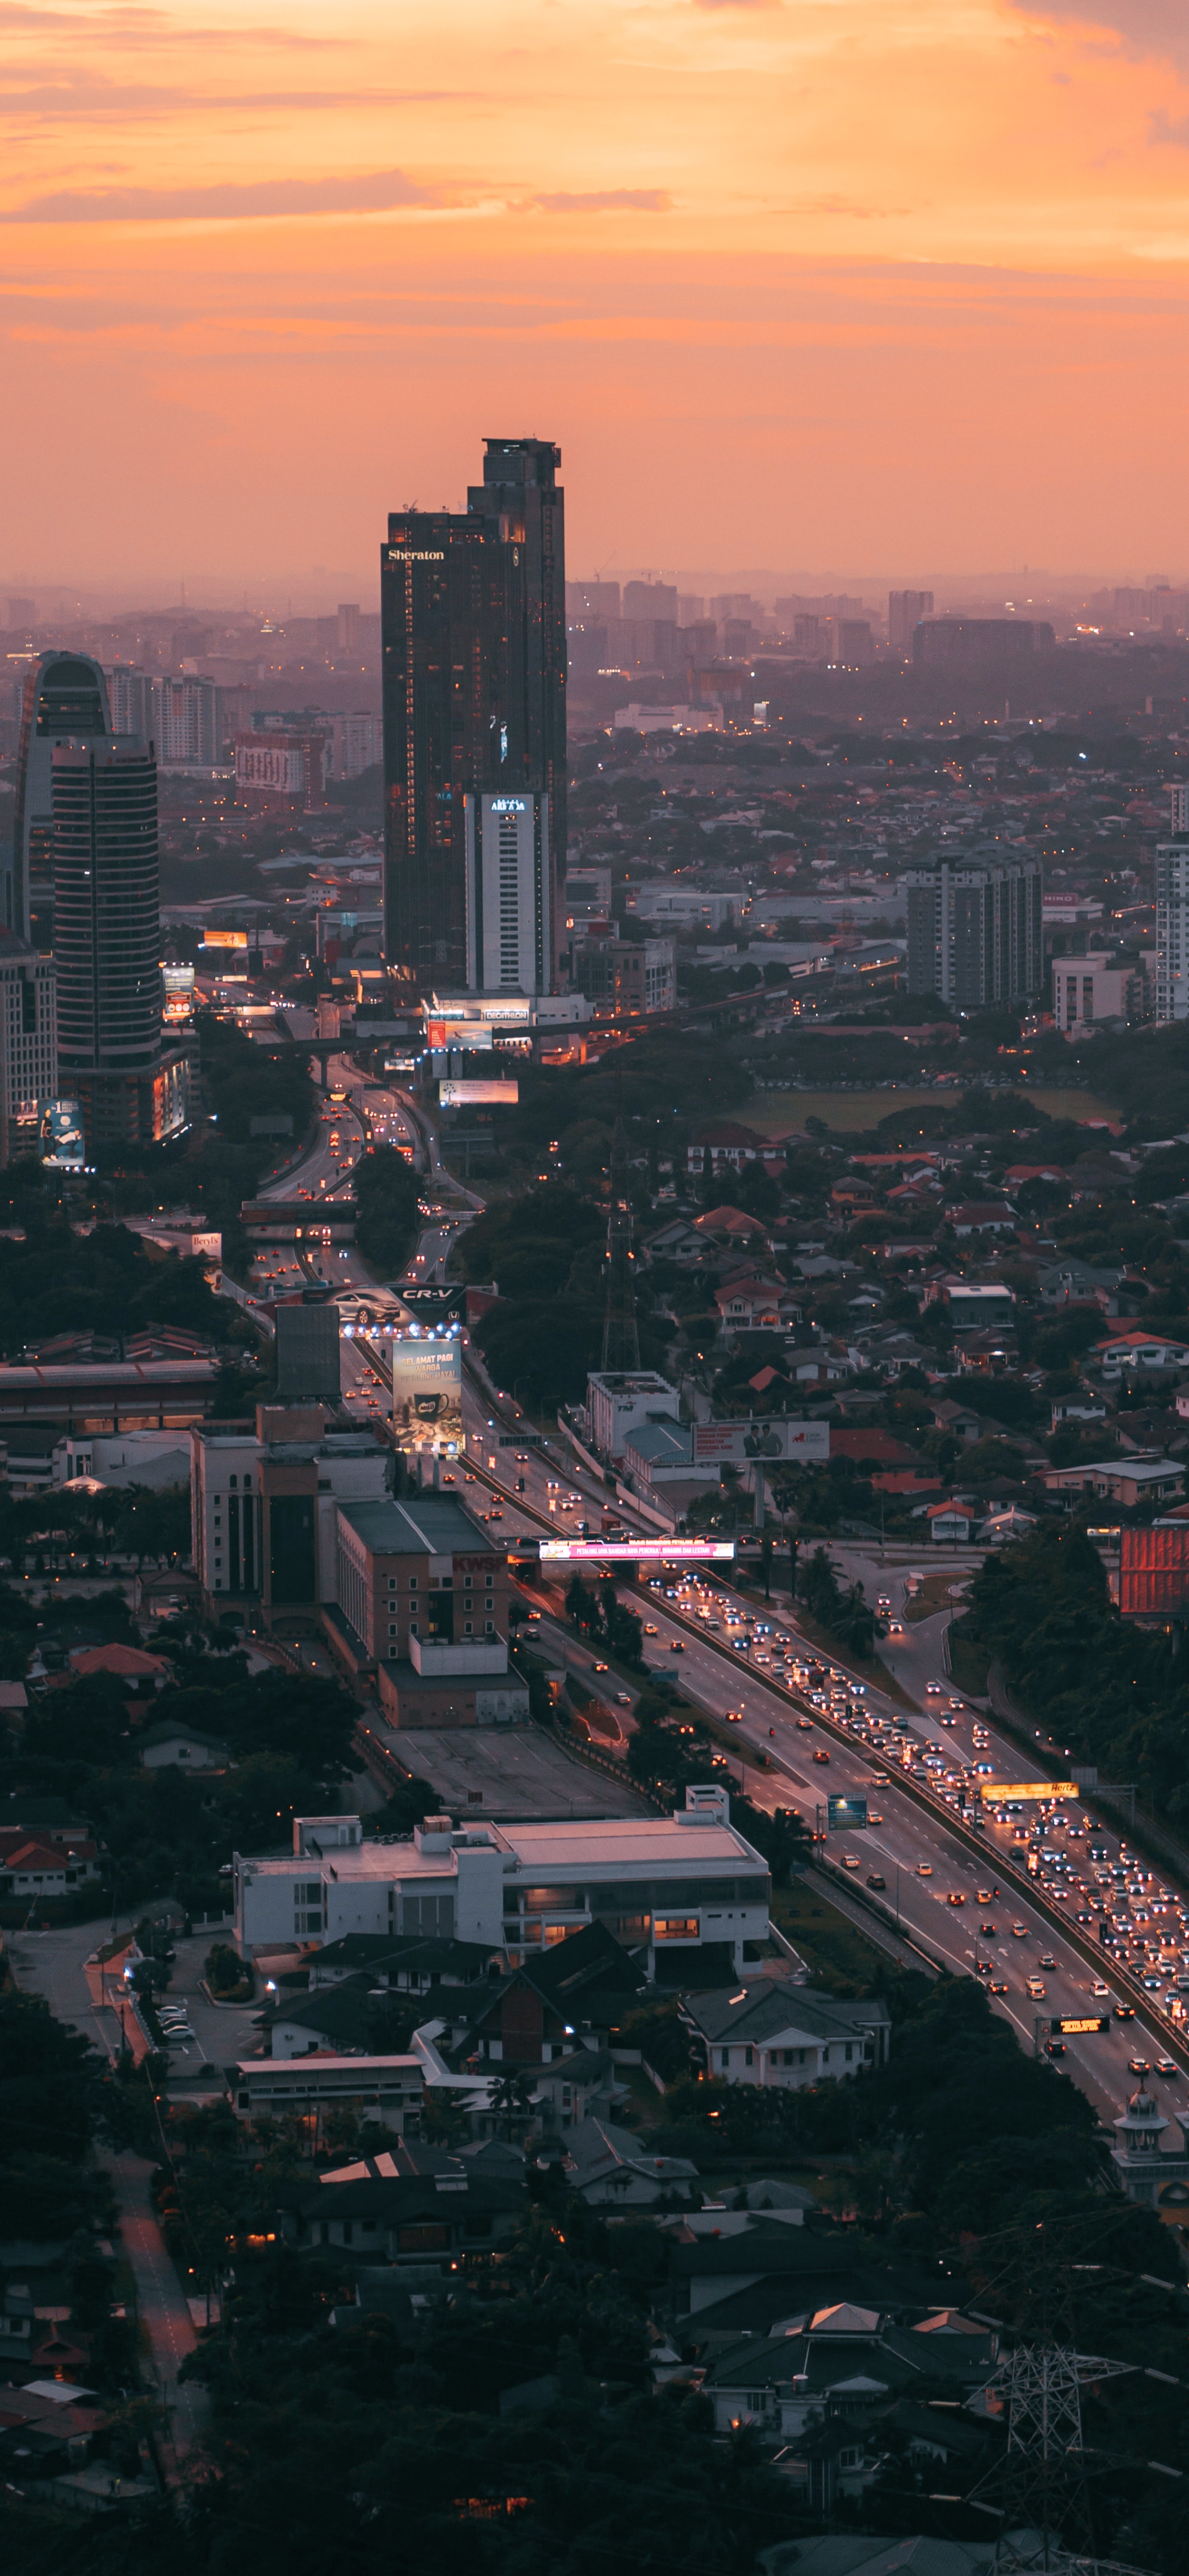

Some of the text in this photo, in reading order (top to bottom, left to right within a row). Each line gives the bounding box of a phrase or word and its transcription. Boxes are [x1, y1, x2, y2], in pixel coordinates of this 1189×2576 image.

[389, 550, 444, 560] Sheraton
[194, 1236, 218, 1247] Beryl's
[403, 1289, 453, 1298] CR-V
[402, 1354, 453, 1366] SELAMAT PAGI
[414, 1363, 440, 1372] WARGA
[453, 1557, 506, 1573] KWSP
